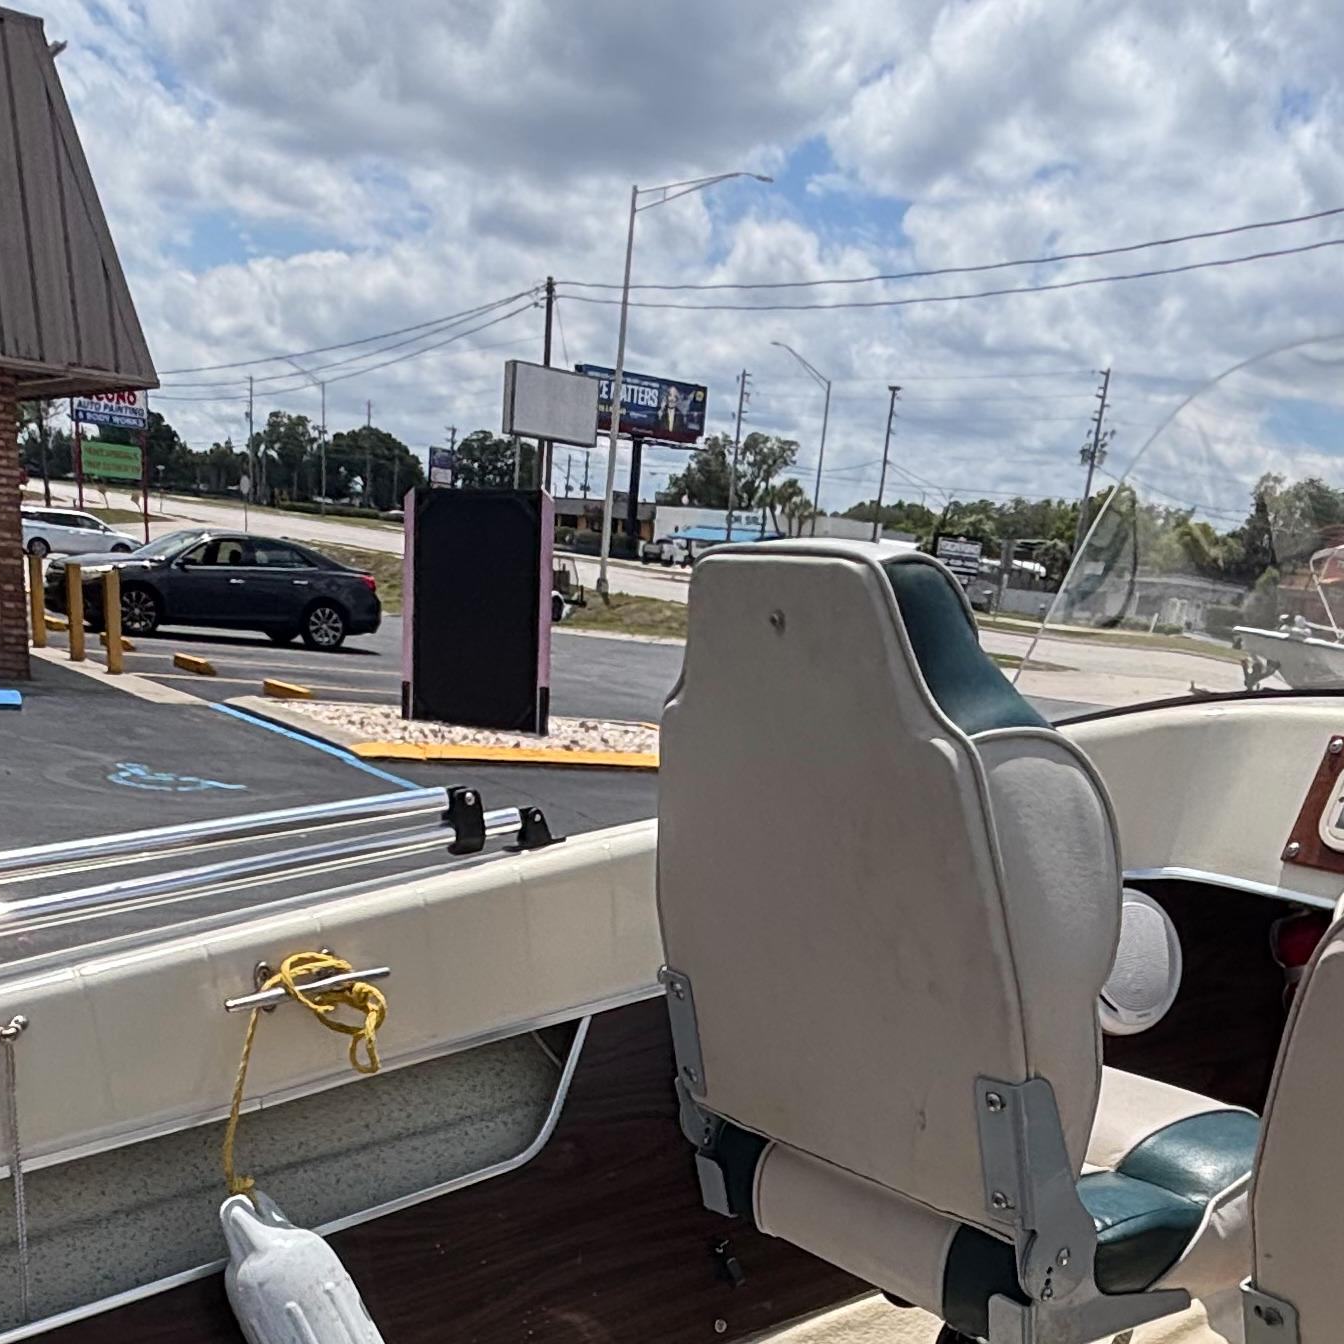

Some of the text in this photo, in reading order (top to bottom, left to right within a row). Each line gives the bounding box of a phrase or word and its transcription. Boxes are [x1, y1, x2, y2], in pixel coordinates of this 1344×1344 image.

[610, 381, 659, 407] ATTERS
[77, 399, 144, 417] AUTO PAINTING
